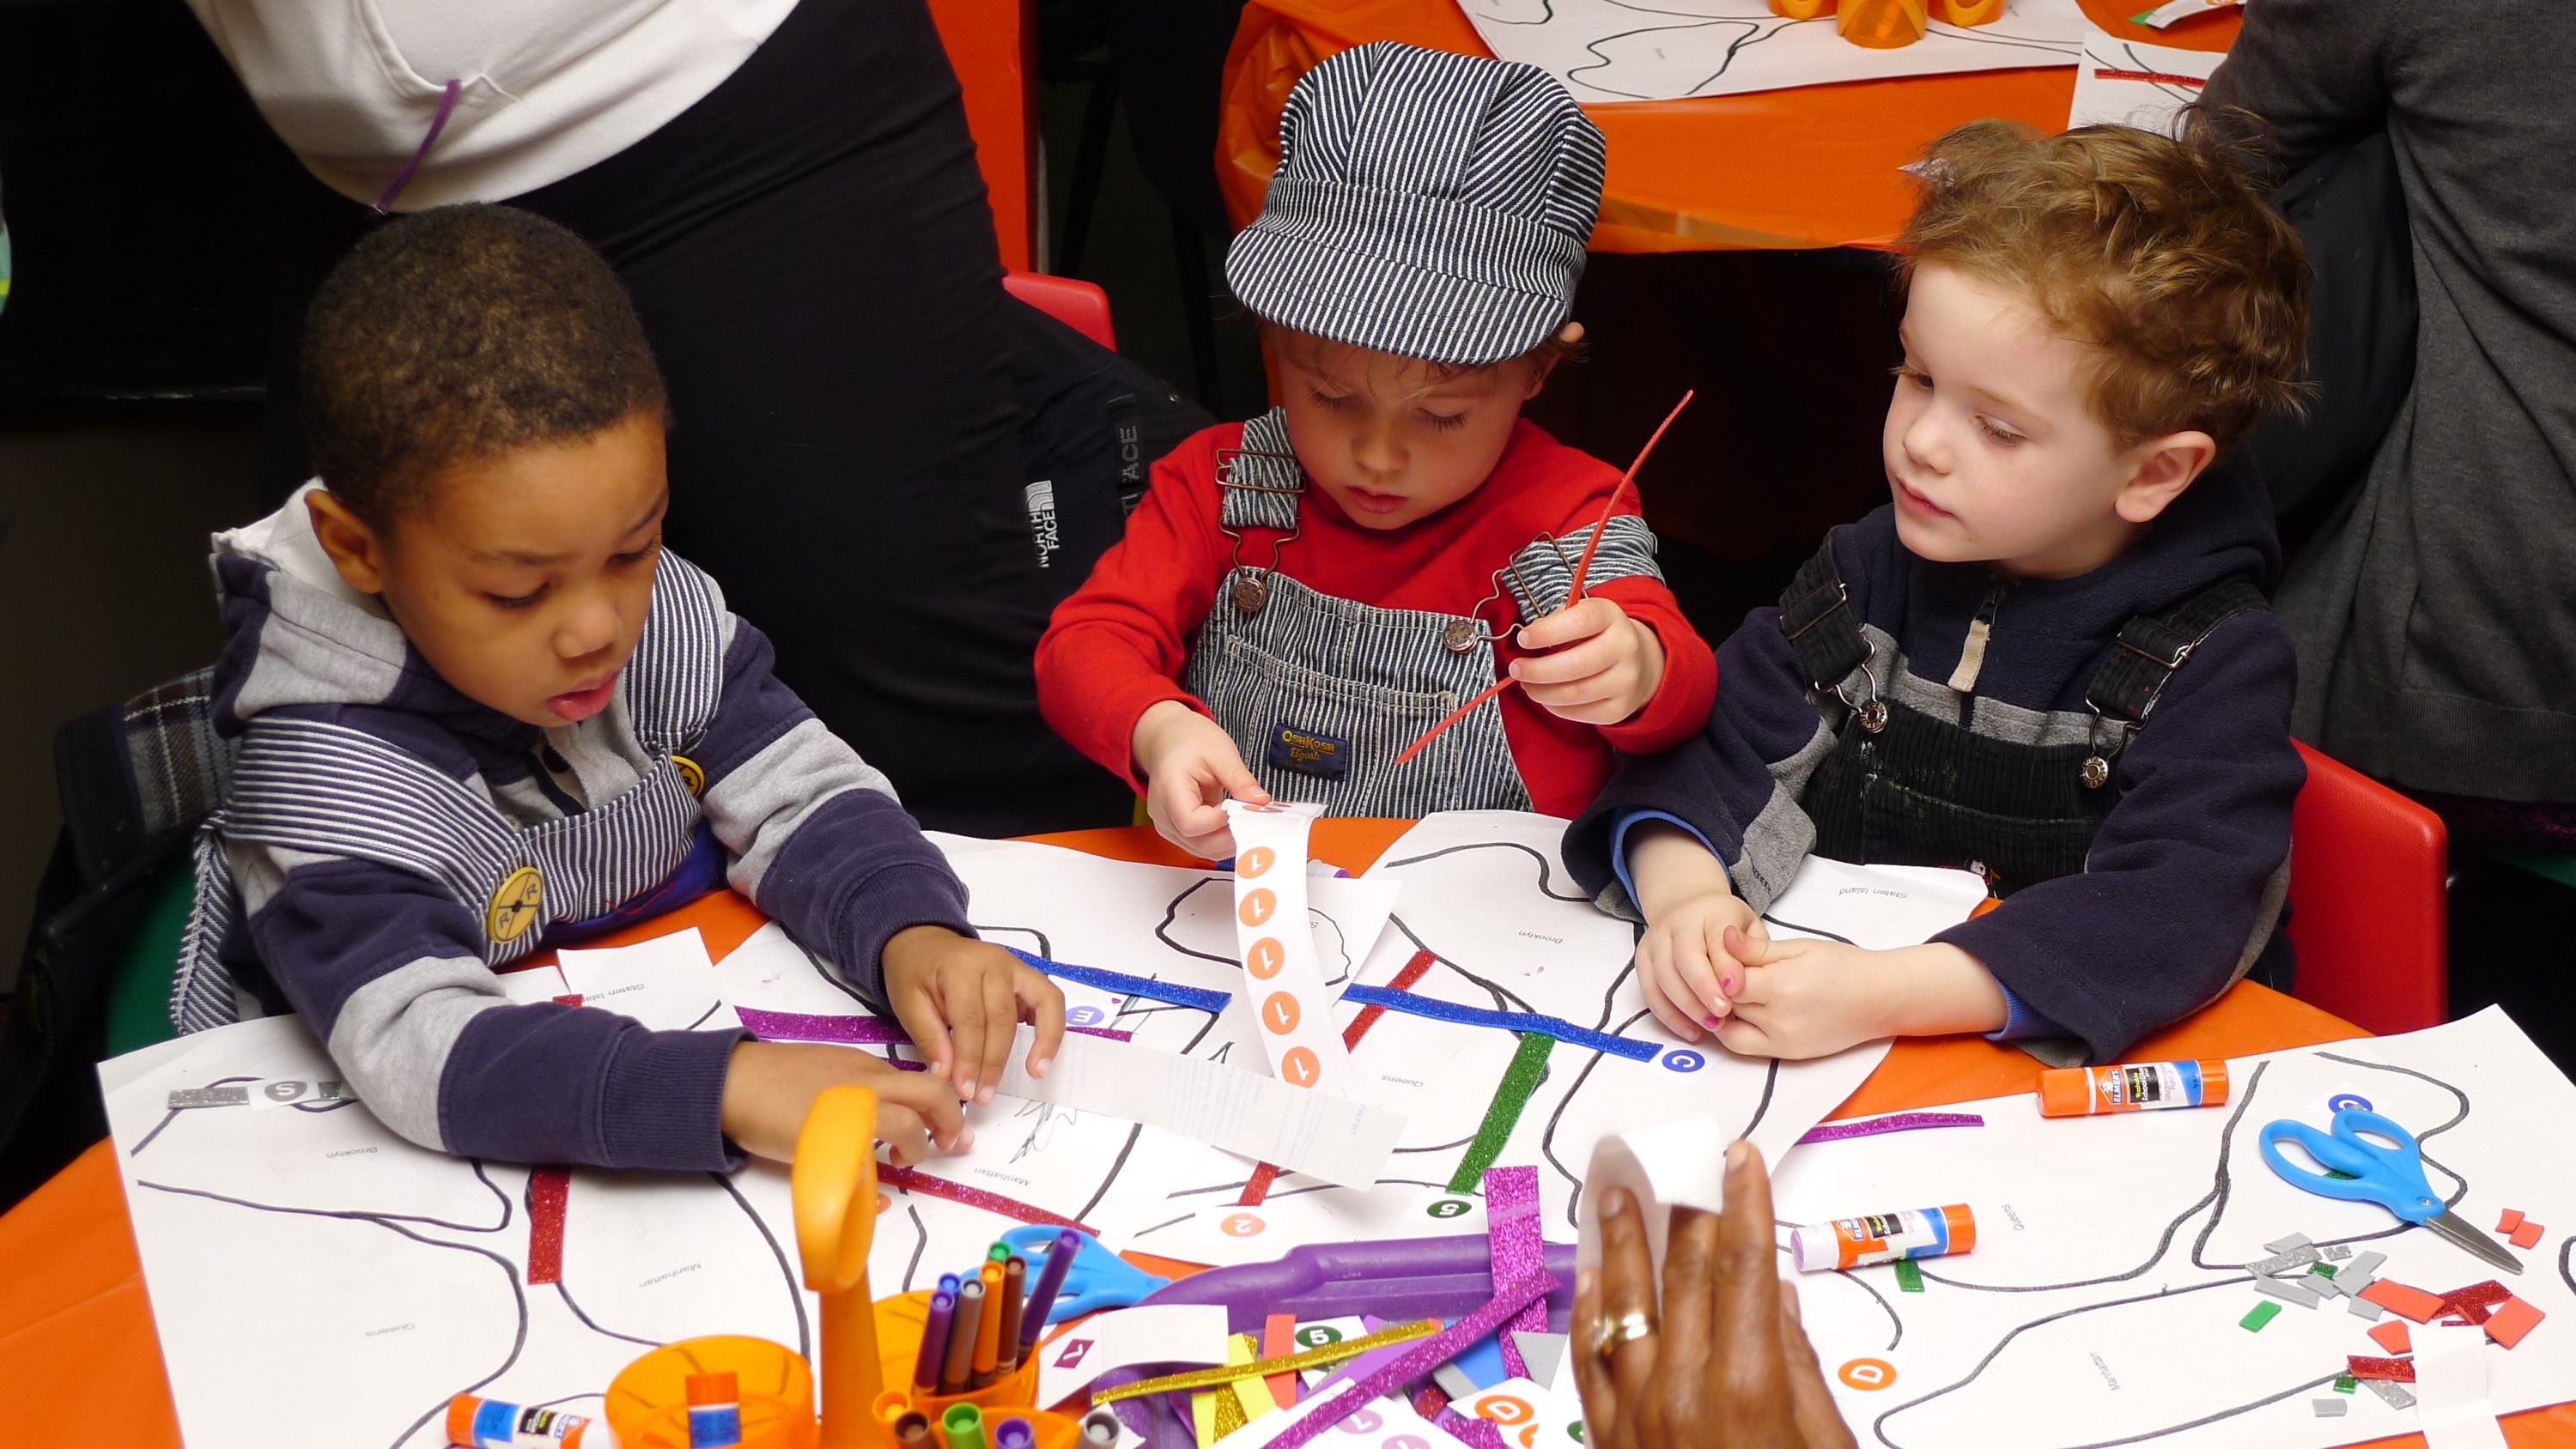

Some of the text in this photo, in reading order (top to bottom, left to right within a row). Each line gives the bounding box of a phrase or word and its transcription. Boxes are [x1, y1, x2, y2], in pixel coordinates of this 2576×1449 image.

[1030, 512, 1050, 568] NORTH
[1042, 511, 1060, 550] FACE
[1251, 853, 1263, 872] 1
[1838, 887, 1908, 899] Staten Island
[1253, 896, 1265, 919] 1
[1517, 931, 1564, 944] Brooklyn
[1261, 946, 1274, 971] 1
[584, 983, 645, 1003] Staten Isla
[1072, 1009, 1095, 1023] E
[1275, 1001, 1291, 1026] 1
[1294, 1056, 1309, 1081] 1
[1671, 1055, 1696, 1068] C
[275, 1082, 295, 1096] S
[1381, 1075, 1424, 1088] Queens
[326, 1146, 379, 1160] Brooklyn
[974, 1167, 1031, 1187] Manhattan
[1438, 1203, 1460, 1216] 5
[2001, 1203, 2025, 1231] Queens
[1235, 1219, 1252, 1234] 2
[638, 1263, 702, 1288] Manhattan
[365, 1323, 416, 1337] Queens
[1309, 1329, 1329, 1345] 5
[1849, 1363, 1885, 1385] D
[2089, 1352, 2120, 1391] Manhattan
[1486, 1400, 1522, 1422] D
